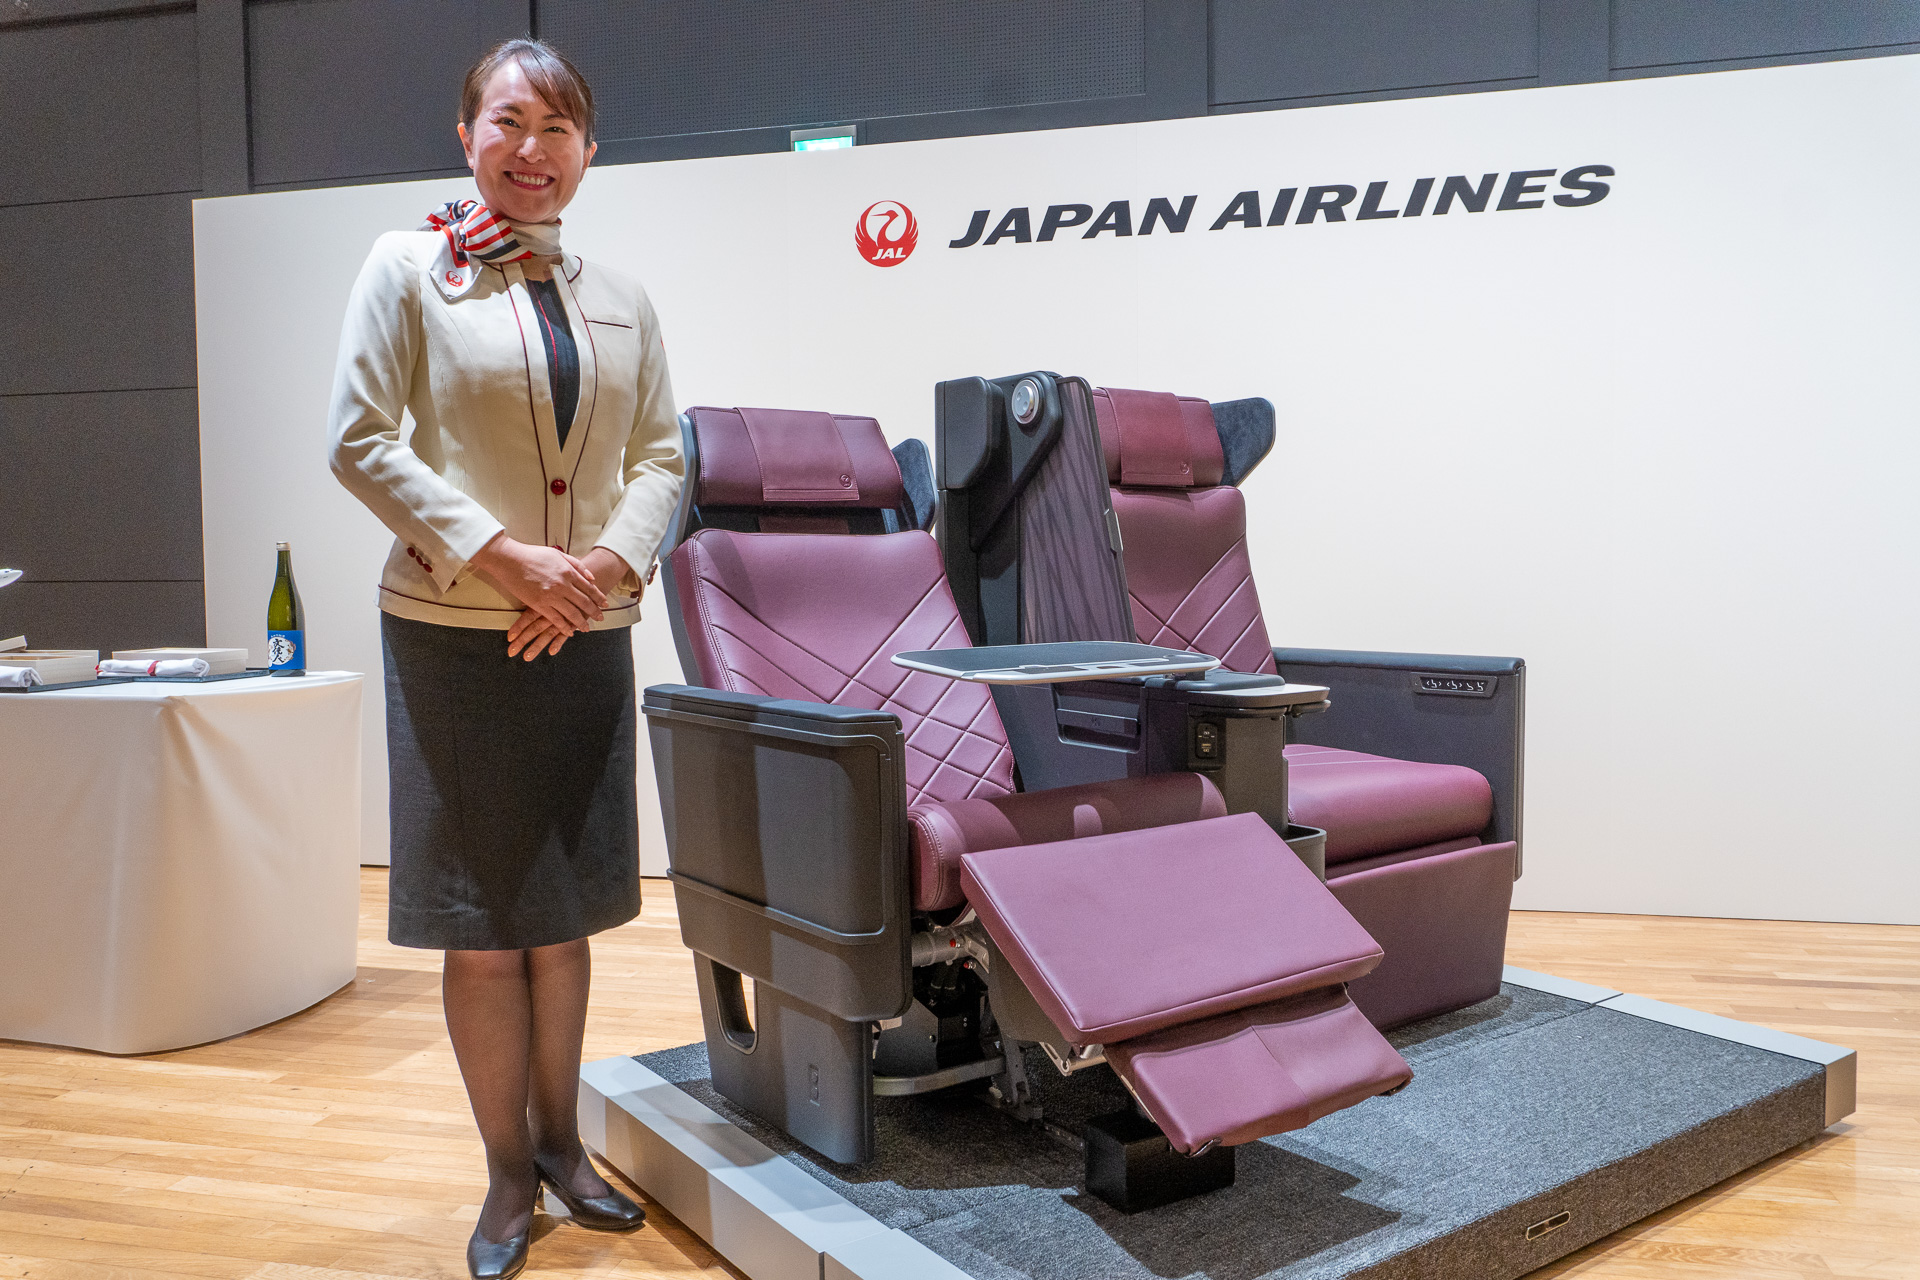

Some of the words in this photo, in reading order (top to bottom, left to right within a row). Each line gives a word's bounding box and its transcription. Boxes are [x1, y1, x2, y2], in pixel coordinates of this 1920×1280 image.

[948, 194, 1198, 249] JAPAN
[1208, 164, 1616, 231] AIRLINES
[871, 247, 907, 260] JAL
